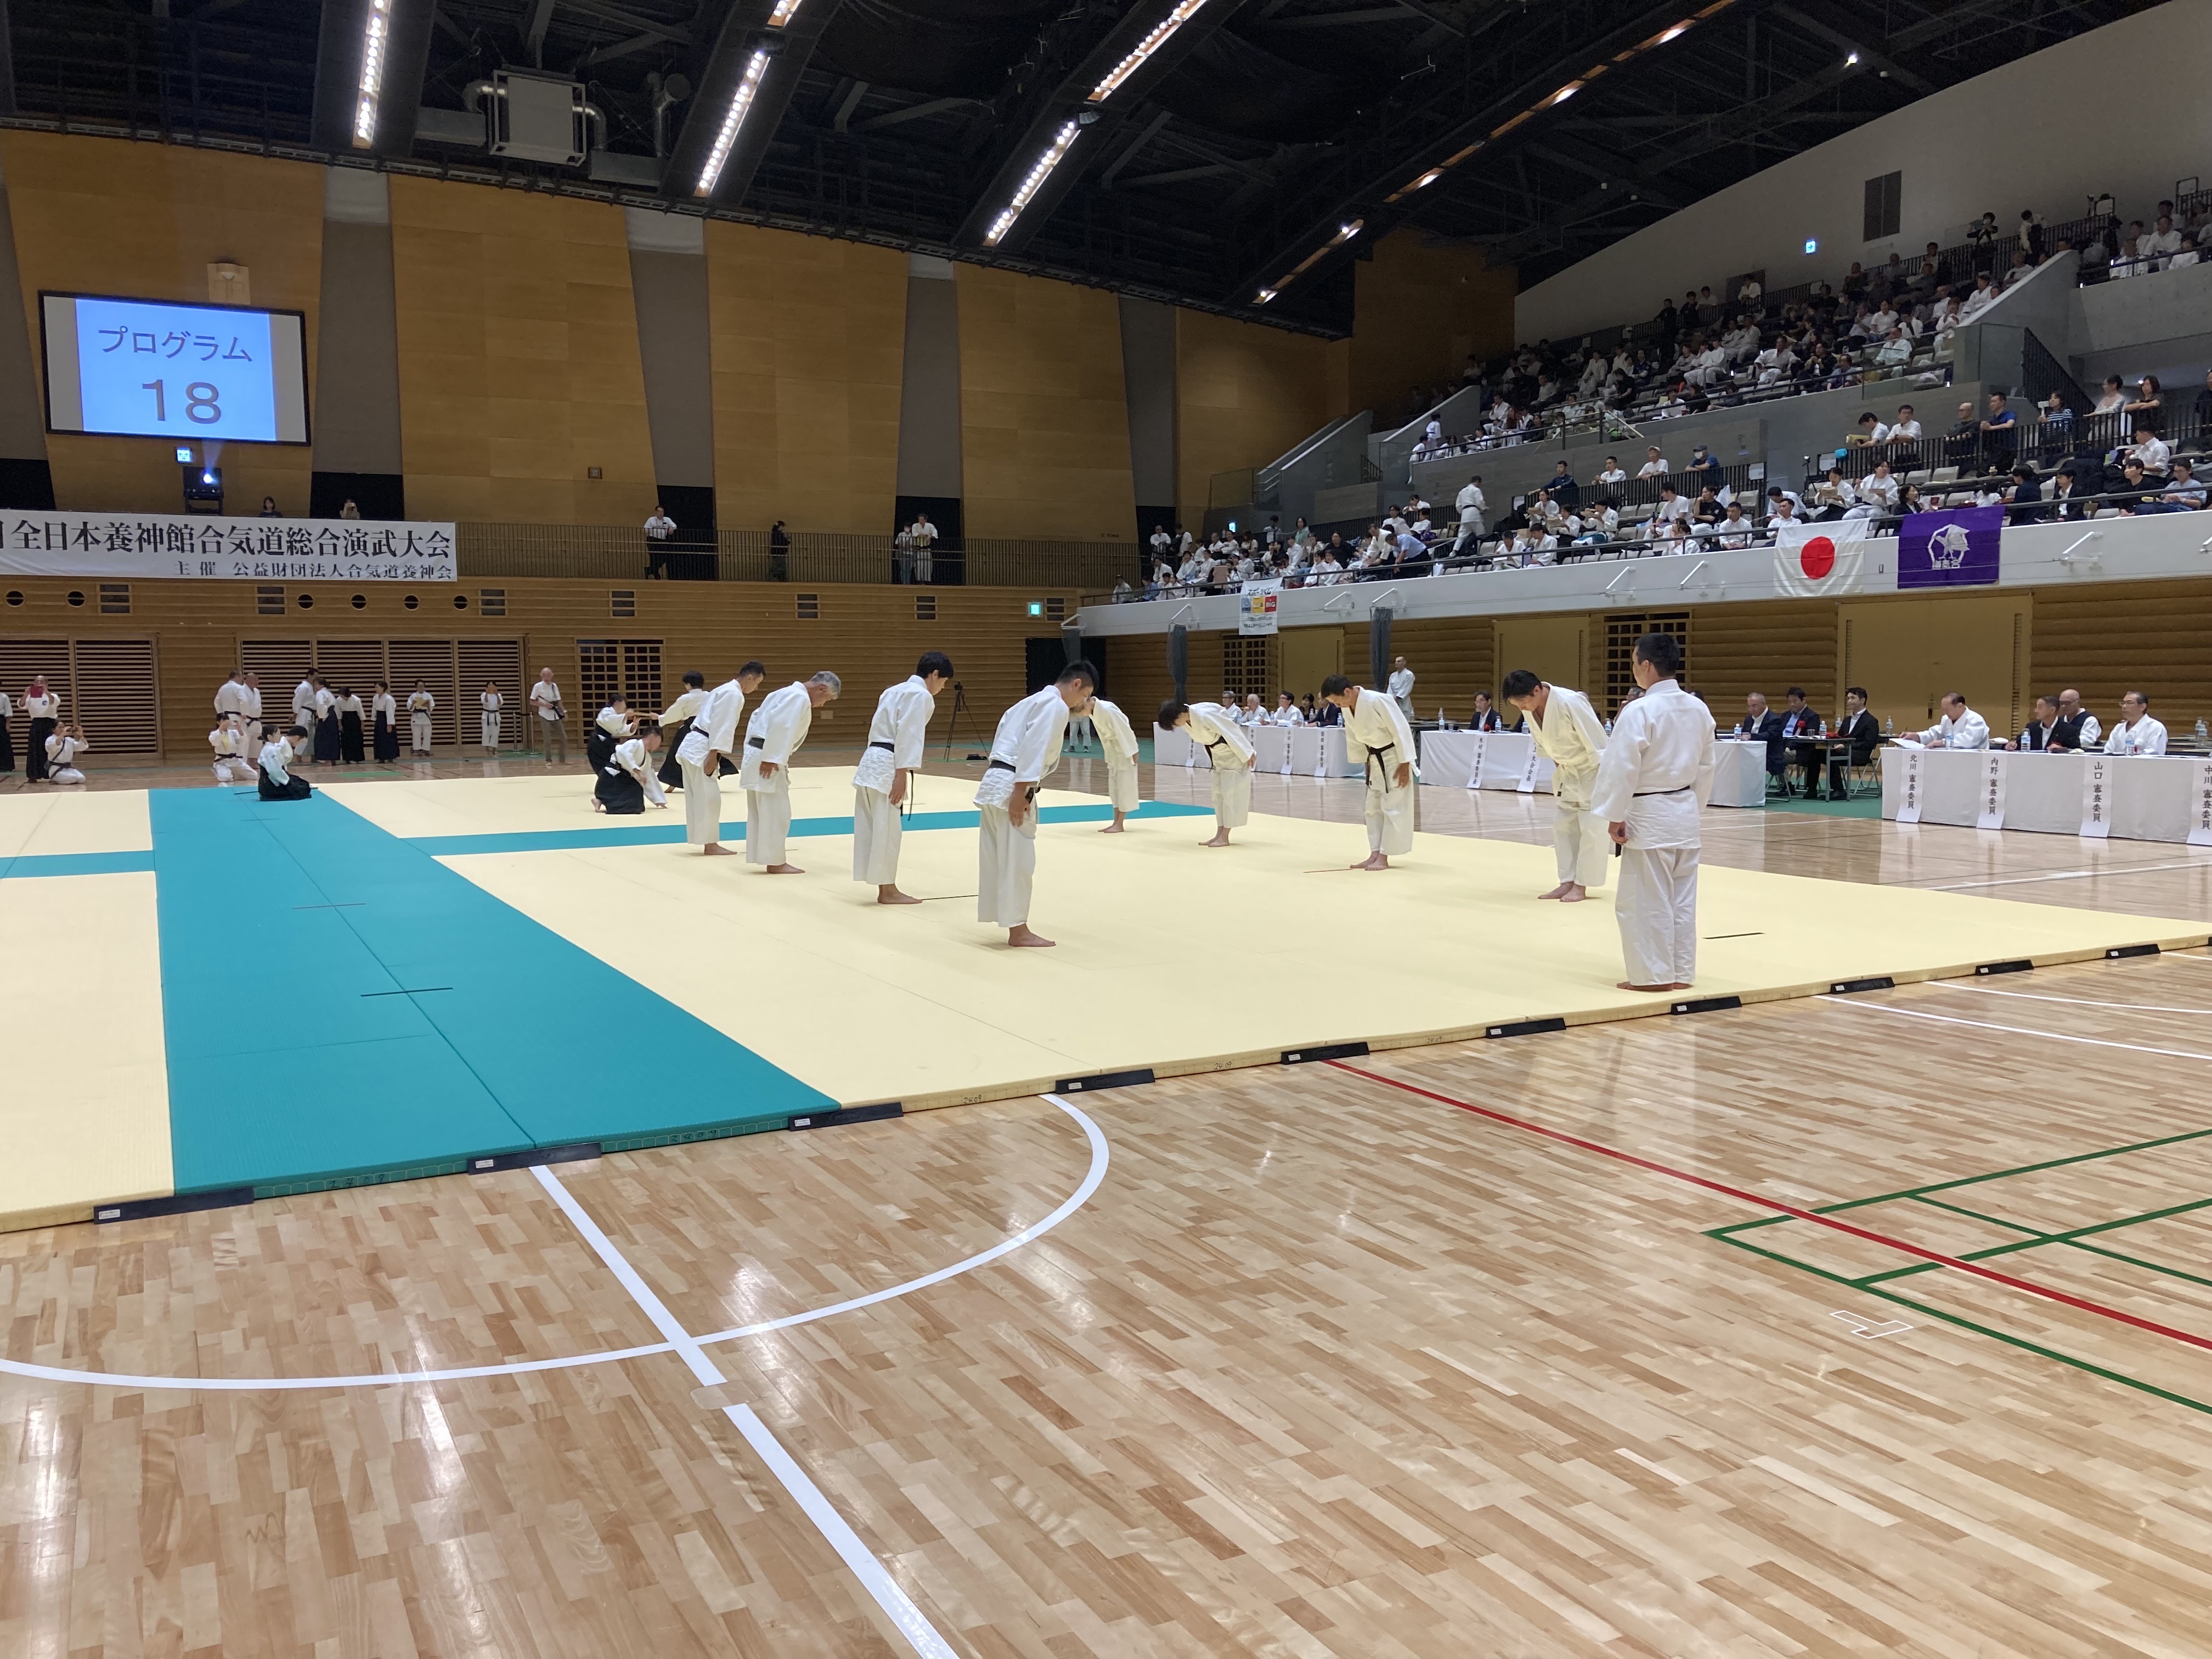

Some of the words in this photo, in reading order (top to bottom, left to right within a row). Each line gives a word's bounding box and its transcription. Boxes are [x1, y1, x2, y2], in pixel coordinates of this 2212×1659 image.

[98, 325, 253, 362] プログラム
[142, 379, 221, 424] 18
[0, 519, 450, 558] 全日本養神館合気道総合演武大会
[233, 562, 452, 579] 公益財団法人合気道養神会
[1909, 754, 1917, 771] 北川
[1990, 757, 1999, 775] 内野
[2094, 761, 2103, 780] 山口
[2203, 765, 2212, 785] 中川
[1907, 774, 1916, 809] 審査委員
[1988, 778, 1998, 815] 審査委員
[2092, 783, 2102, 822] 審査委員
[2201, 789, 2212, 830] 審査委員
[963, 1094, 981, 1104] 2409
[671, 1130, 716, 1142] 2409
